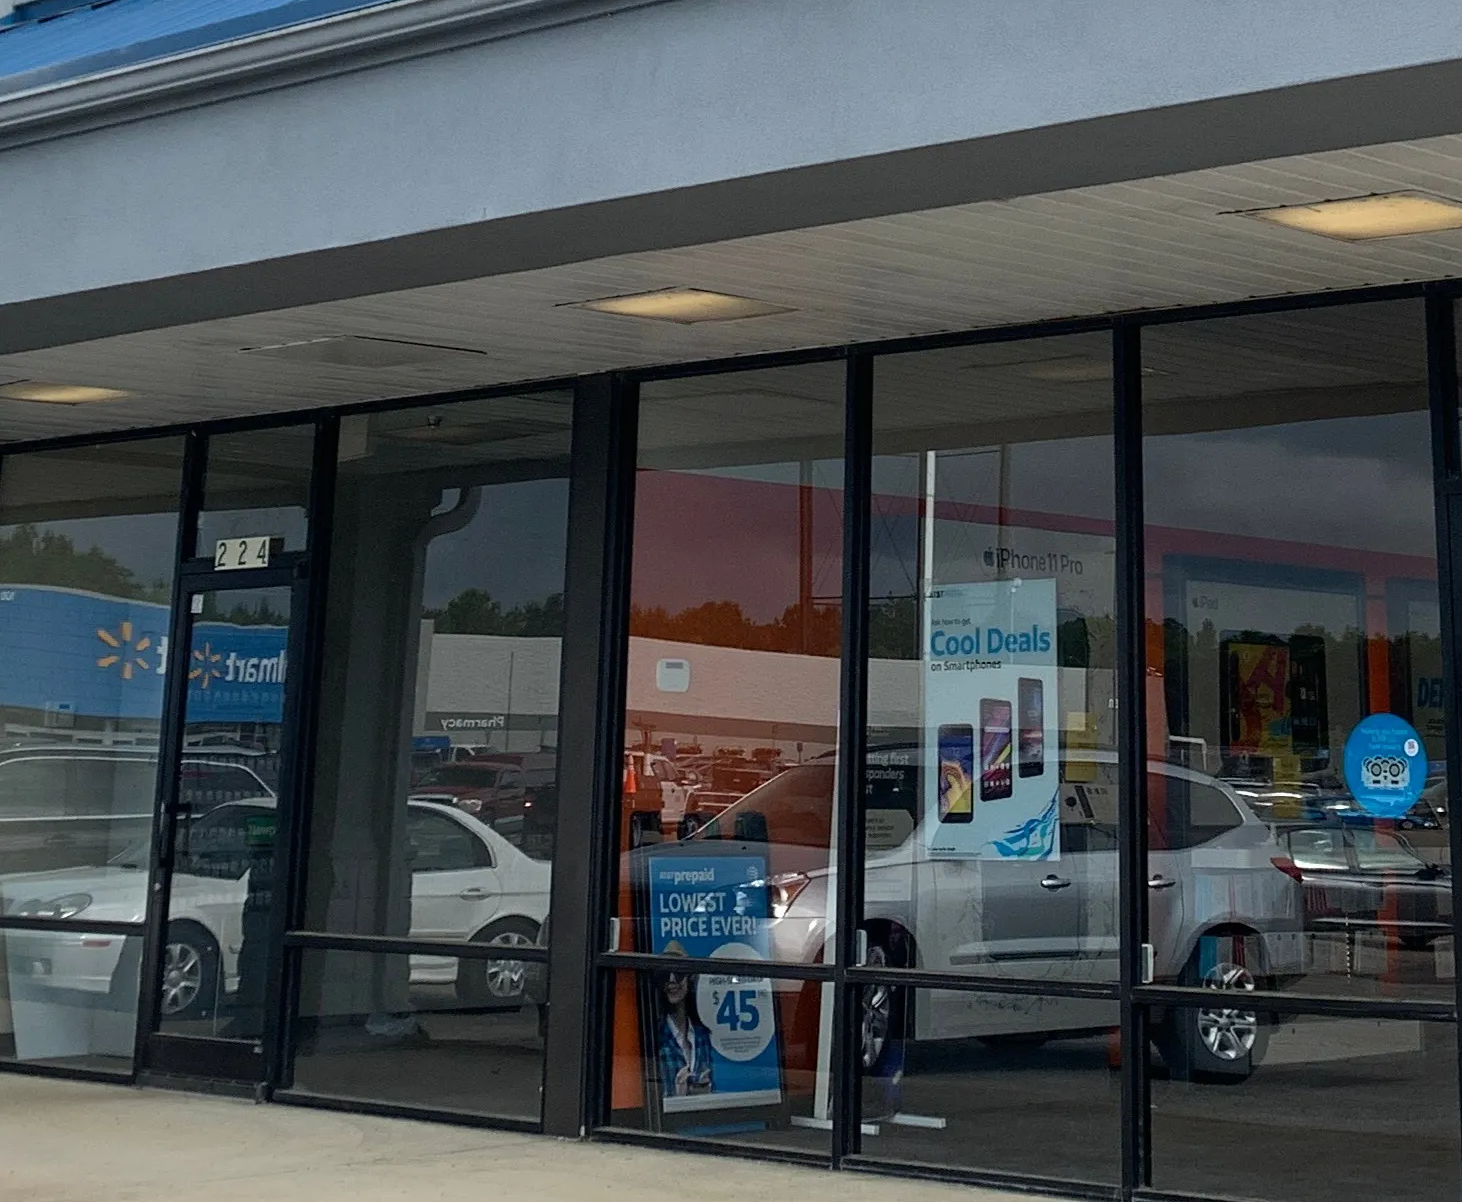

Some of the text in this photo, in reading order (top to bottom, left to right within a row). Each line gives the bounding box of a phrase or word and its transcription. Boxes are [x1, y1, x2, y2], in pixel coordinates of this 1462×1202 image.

[216, 540, 267, 568] 224
[996, 549, 1046, 572] iPhone
[1061, 556, 1083, 575] Pro
[931, 624, 1051, 656] Cool Deals
[931, 659, 1001, 673] on Smartphones
[674, 868, 715, 886] prepaid
[660, 892, 726, 913] LOWEST
[661, 915, 757, 938] PRICE EVER!
